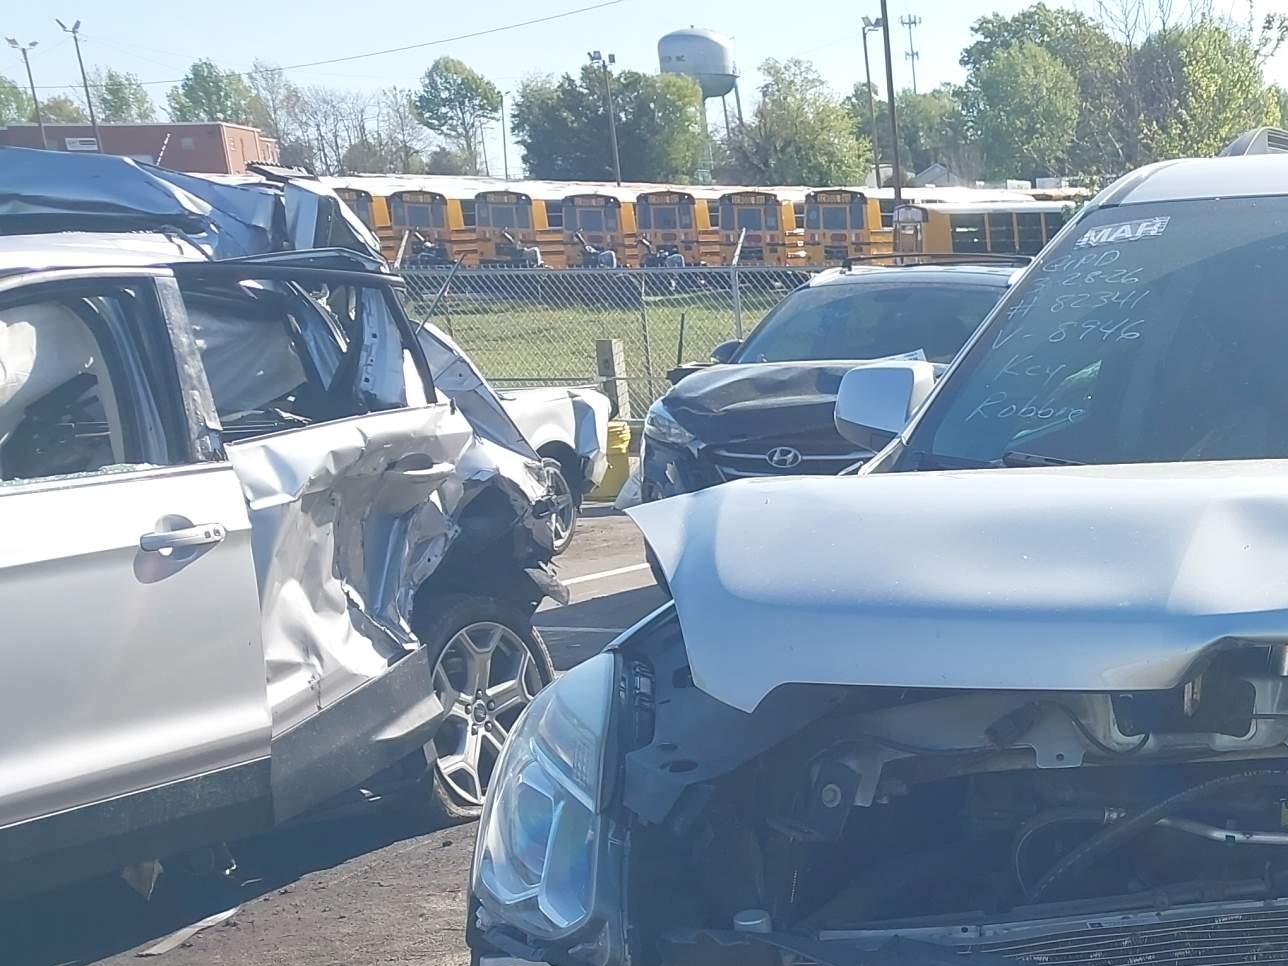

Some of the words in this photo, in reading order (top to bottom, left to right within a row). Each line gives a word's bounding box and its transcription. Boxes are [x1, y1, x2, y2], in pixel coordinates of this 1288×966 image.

[1050, 290, 1150, 312] 82341
[1048, 318, 1145, 343] 8946
[994, 354, 1067, 386] Key
